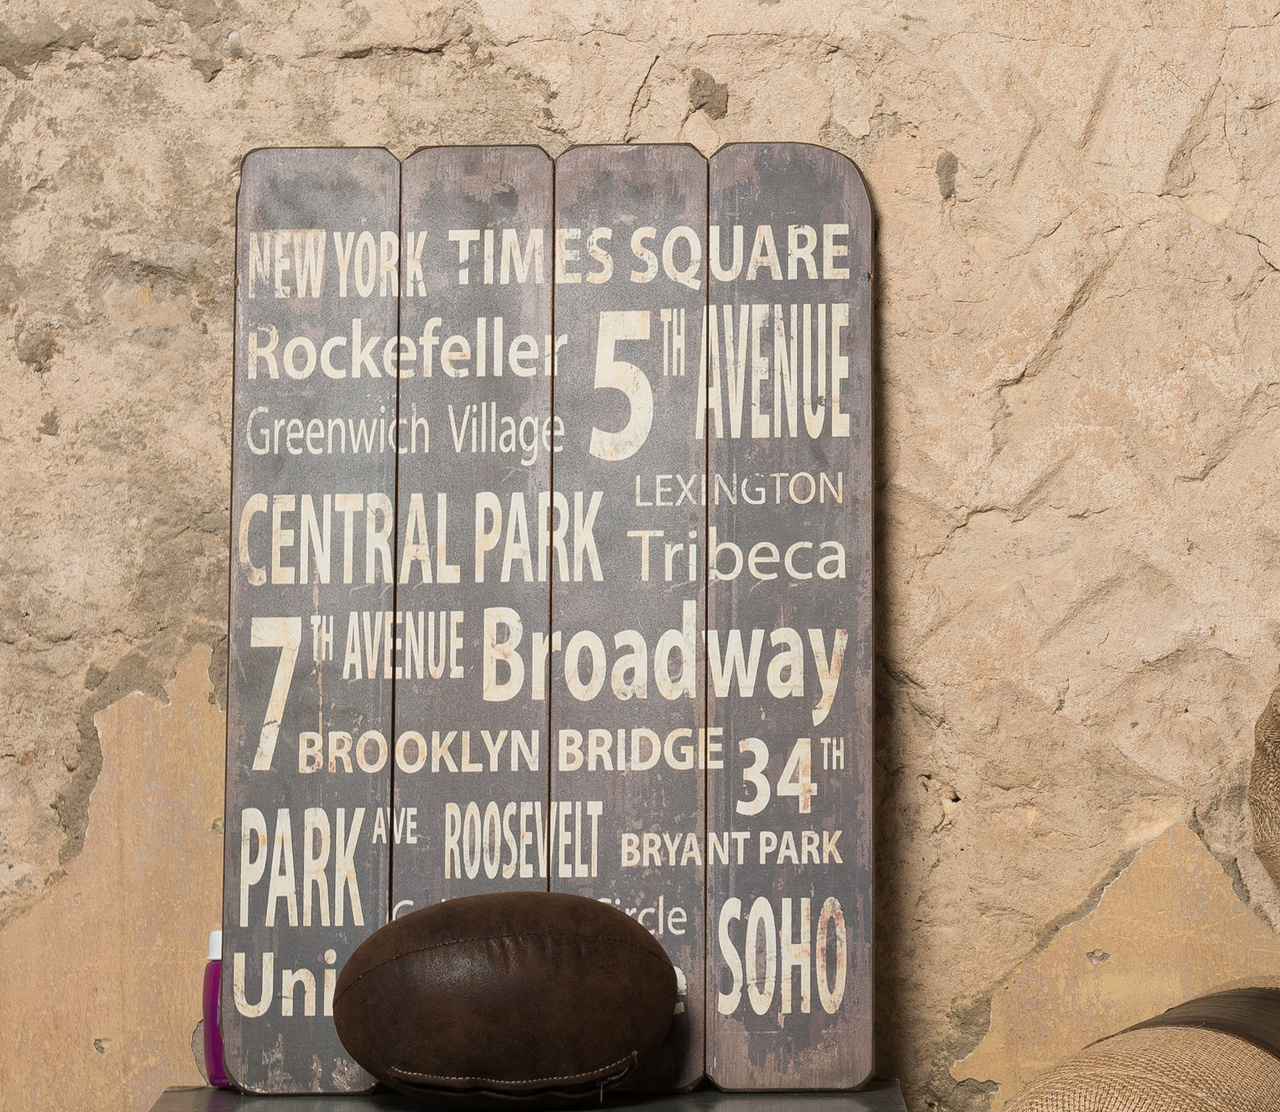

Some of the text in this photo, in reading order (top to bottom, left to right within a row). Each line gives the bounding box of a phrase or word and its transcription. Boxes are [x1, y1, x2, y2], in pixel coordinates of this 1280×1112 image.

[250, 223, 850, 298] NEW YORK TIMES SQUARE
[247, 318, 568, 379] Rockefeller
[695, 303, 850, 440] AVENUE
[247, 402, 565, 465] Greenwich Village
[635, 472, 843, 508] LEXINGTON
[239, 491, 604, 586] CENTRAL PARK
[628, 526, 847, 581] Tribeca
[342, 610, 464, 680] AVENUE
[482, 600, 848, 726] Broadway
[298, 727, 725, 773] BROOKLYN BRIDGE
[240, 807, 418, 927] PARK AVE
[445, 800, 602, 880] ROOSEVELT
[621, 829, 844, 868] BRYANT PARK
[718, 896, 846, 1015] SOHO
